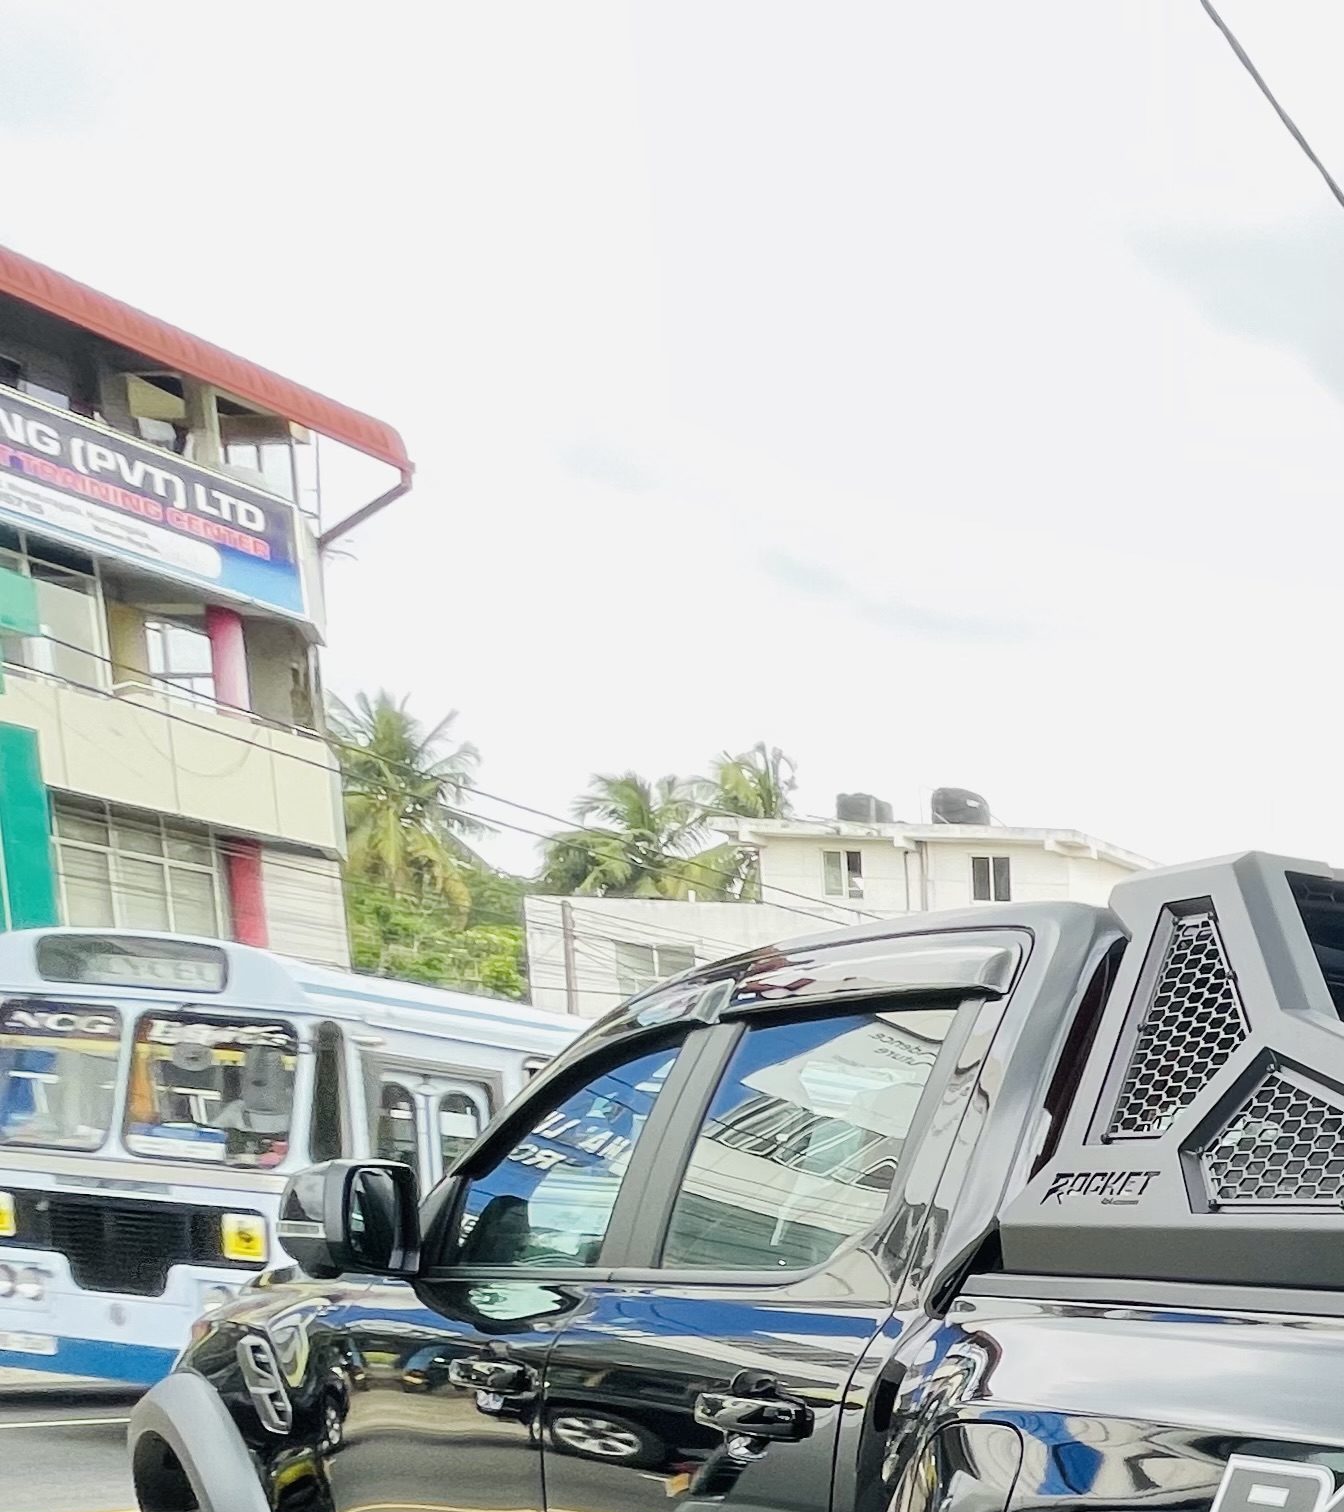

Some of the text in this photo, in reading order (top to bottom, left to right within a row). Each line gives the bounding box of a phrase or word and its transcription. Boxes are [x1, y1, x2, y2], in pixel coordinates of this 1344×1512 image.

[15, 450, 163, 520] TRAINING
[166, 506, 271, 561] CENTER
[70, 437, 187, 510] (PVT)
[194, 482, 266, 533] LTD
[1040, 1171, 1161, 1205] ROCKET
